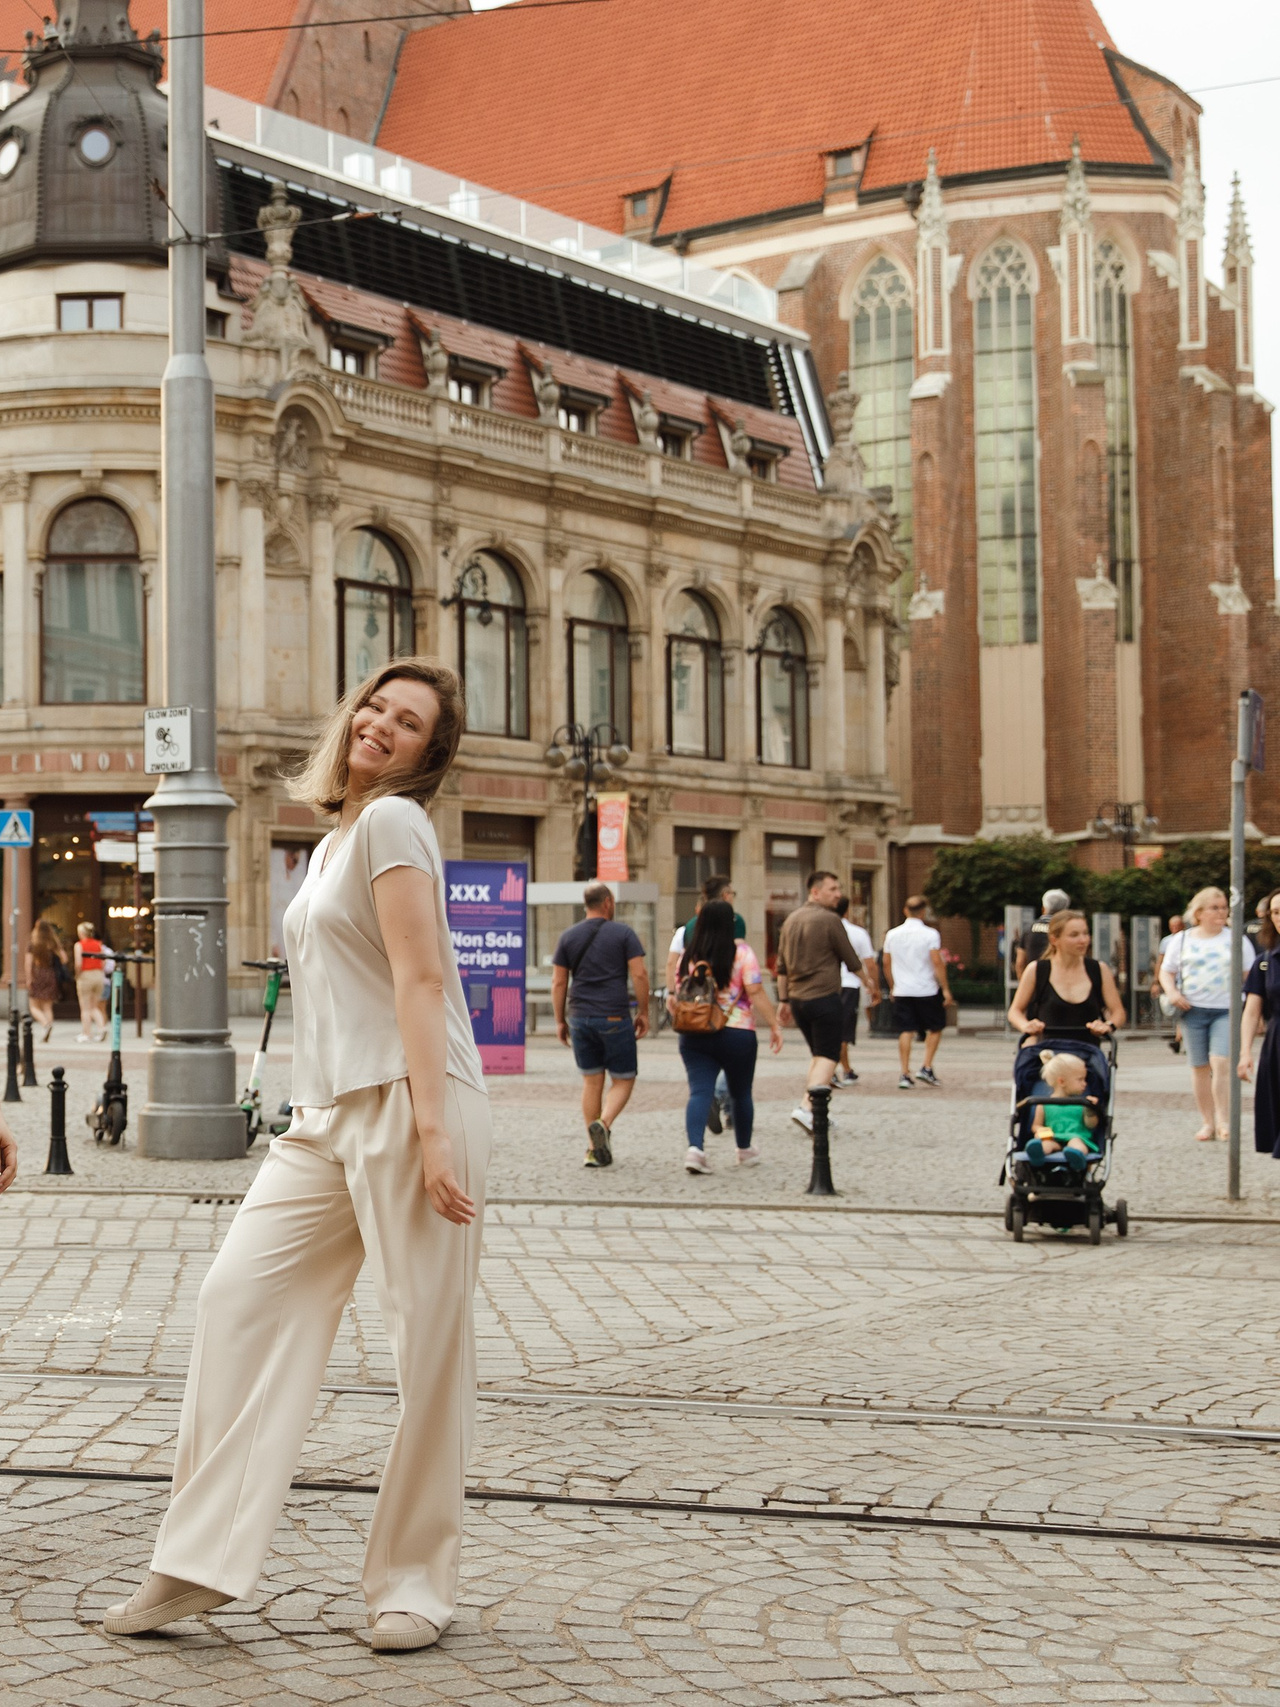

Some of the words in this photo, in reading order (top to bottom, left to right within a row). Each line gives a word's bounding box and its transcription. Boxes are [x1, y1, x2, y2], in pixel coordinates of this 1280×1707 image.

[148, 710, 167, 720] SLOW
[169, 708, 188, 718] ZONE
[449, 883, 491, 902] XXX
[450, 930, 484, 948] Non
[484, 930, 523, 949] Sola
